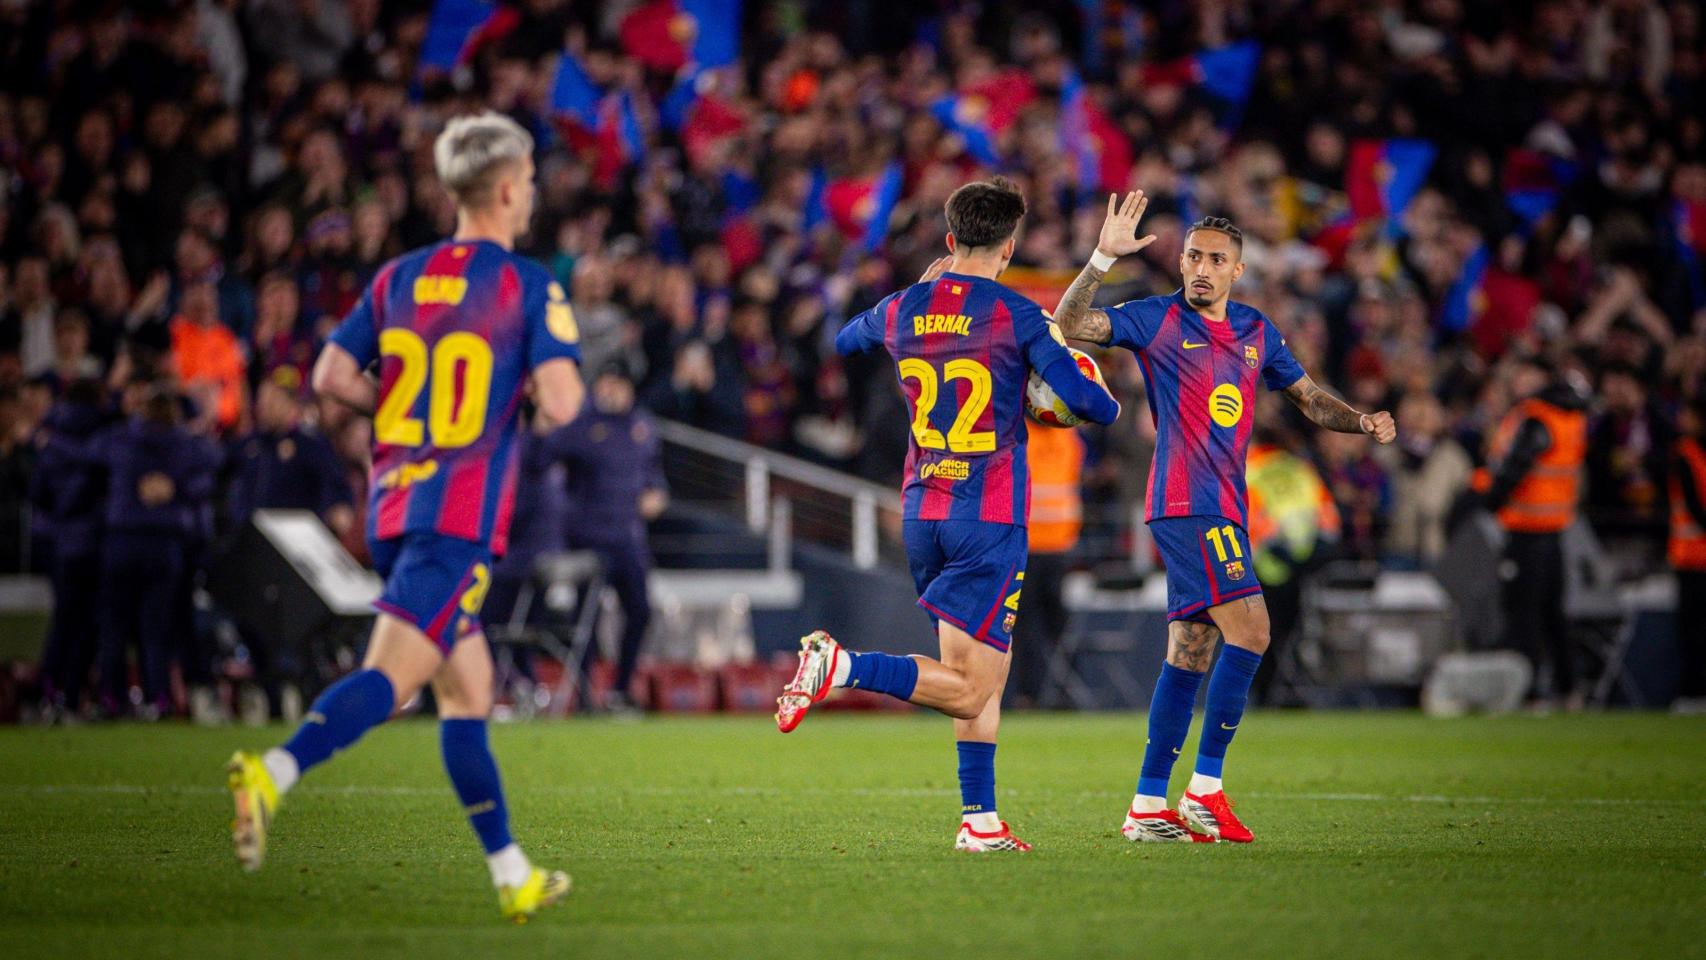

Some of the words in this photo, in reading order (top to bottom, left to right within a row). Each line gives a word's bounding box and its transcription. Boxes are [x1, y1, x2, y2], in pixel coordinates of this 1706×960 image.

[913, 314, 973, 337] BERNAL
[374, 327, 494, 448] 20
[898, 358, 996, 453] 22
[933, 467, 969, 477] ACNUR
[1206, 525, 1243, 562] 11
